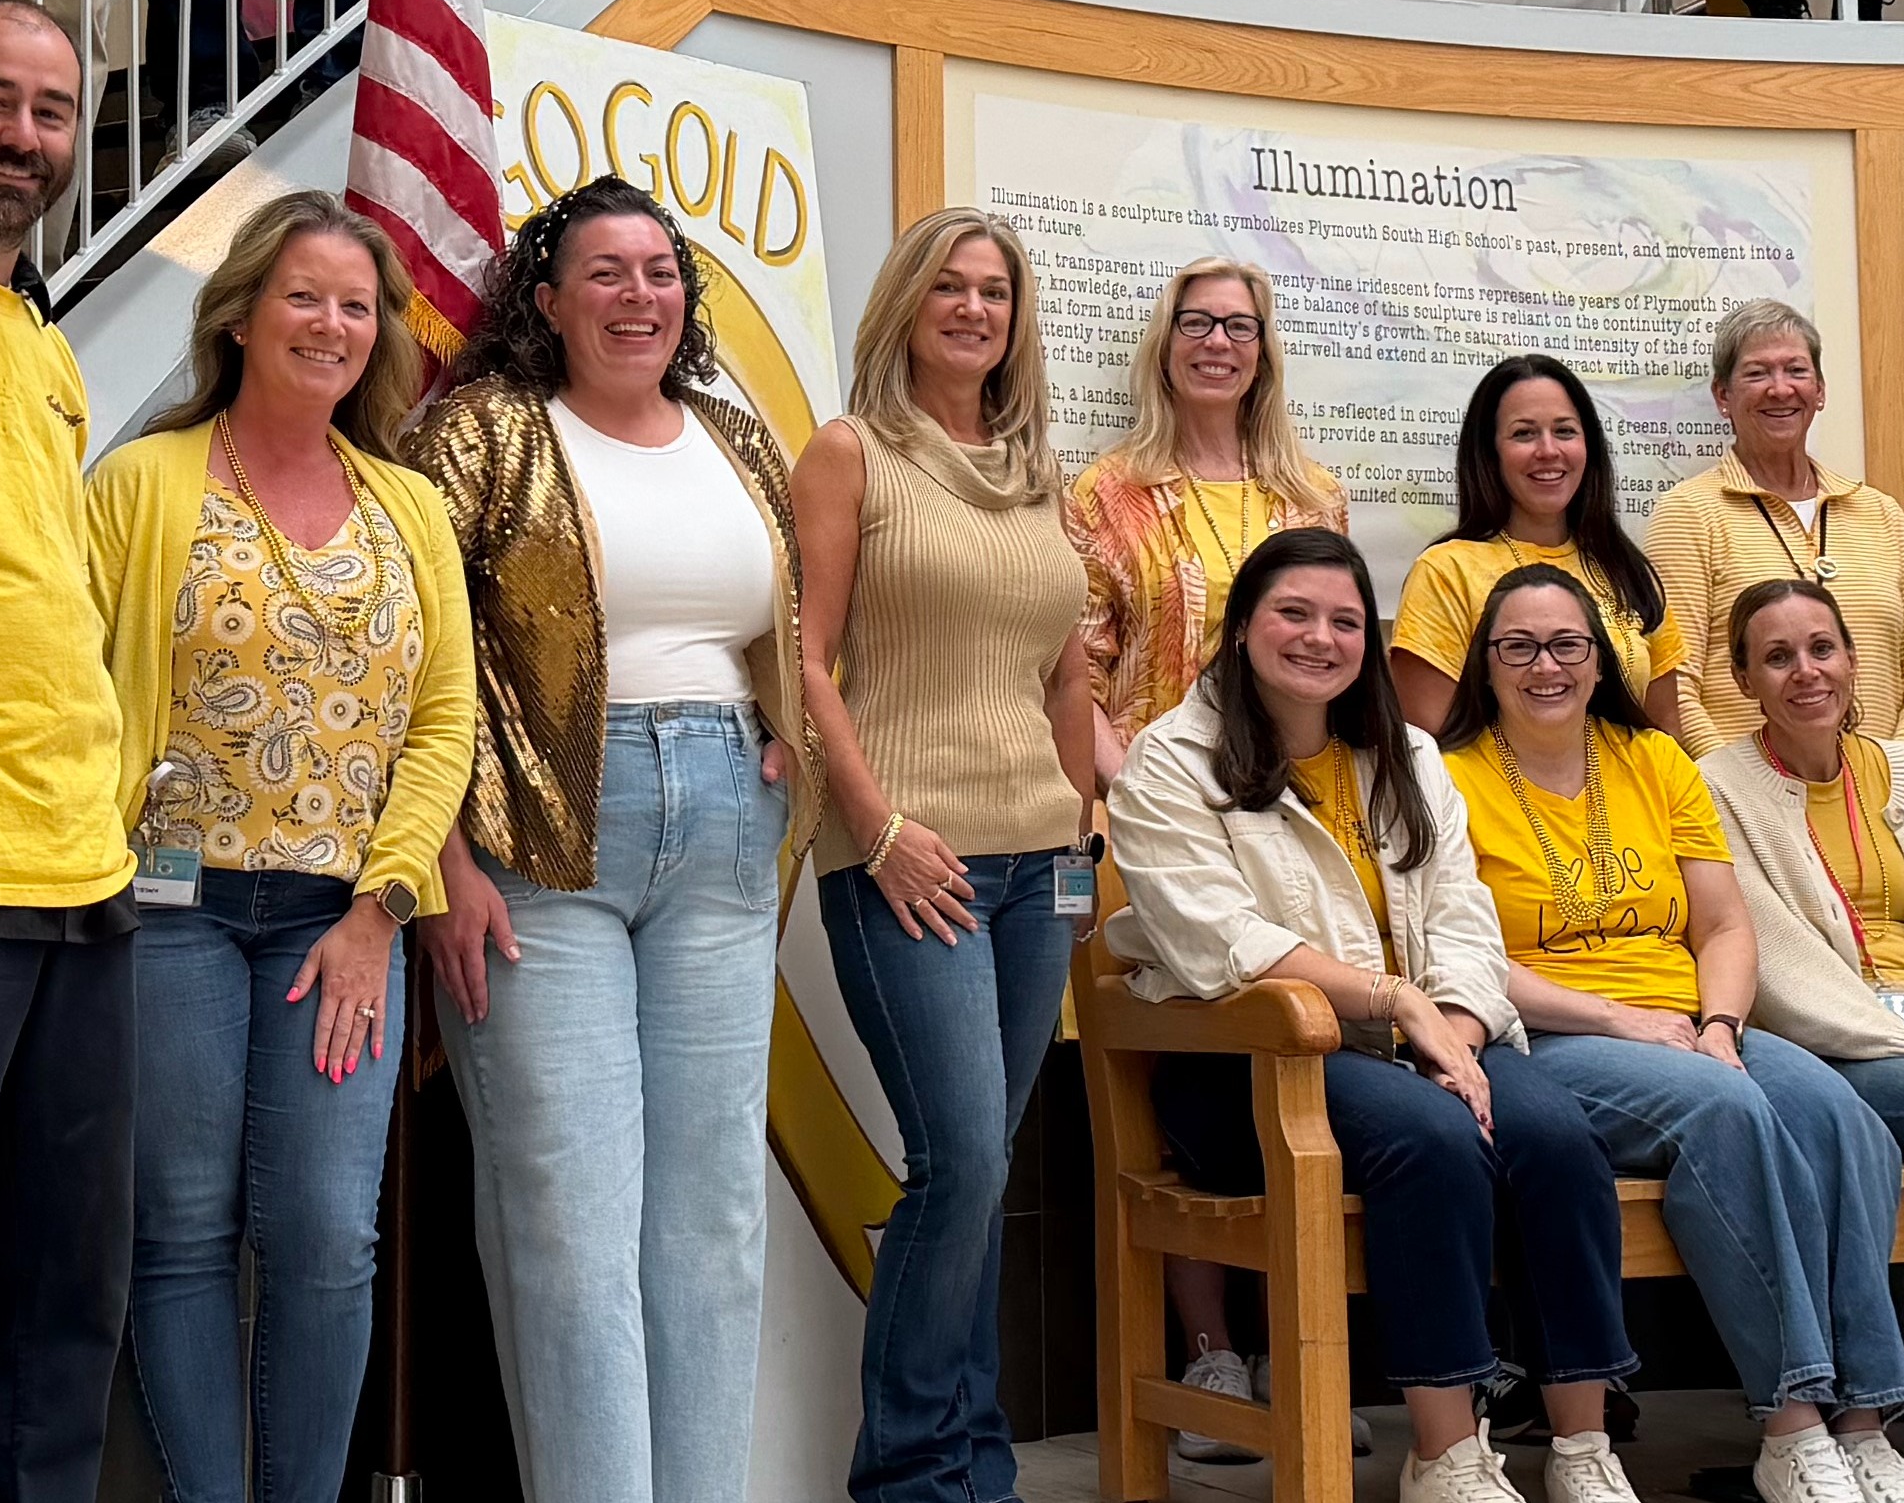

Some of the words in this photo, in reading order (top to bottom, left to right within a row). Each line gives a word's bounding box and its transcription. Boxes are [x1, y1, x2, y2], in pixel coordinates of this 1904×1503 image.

[603, 79, 808, 267] GOLD
[1251, 147, 1519, 213] Illumination
[991, 187, 1077, 213] Illumination
[1083, 199, 1093, 215] is
[1099, 204, 1107, 216] a
[1112, 204, 1183, 224] sculpture
[1188, 210, 1219, 227] that
[1224, 214, 1303, 234] symbolizes
[1308, 220, 1377, 240] Plymouth
[1382, 225, 1423, 243] South
[1428, 229, 1460, 248] High
[1465, 232, 1522, 250] School's
[1526, 239, 1561, 256] past,
[1566, 241, 1627, 259] present,
[1633, 242, 1661, 257] and
[1666, 245, 1745, 259] movement
[1751, 245, 1781, 260] into
[1786, 248, 1794, 260] a
[1038, 216, 1086, 237] future.
[1050, 275, 1132, 300] knowledge,
[1136, 284, 1163, 301] and
[1275, 293, 1299, 310] The
[1304, 296, 1359, 314] balance
[1364, 300, 1378, 316] of
[1382, 301, 1409, 317] this
[1414, 304, 1481, 323] sculpture
[1486, 308, 1497, 323] is
[1502, 309, 1551, 326] reliant
[1555, 316, 1571, 328] on
[1576, 314, 1598, 330] the
[1603, 317, 1683, 336] continuity
[1687, 318, 1702, 333] of
[1055, 252, 1145, 276] transparent
[1271, 272, 1353, 294] wenty-nine
[1356, 277, 1429, 297] iridescent
[1434, 282, 1474, 300] forms
[1479, 286, 1548, 305] represent
[1553, 291, 1575, 307] the
[1579, 296, 1620, 311] years
[1625, 294, 1639, 310] of
[1643, 295, 1717, 314] Plymouth
[1067, 299, 1102, 318] form
[1107, 305, 1134, 320] and
[1139, 309, 1150, 321] is
[1277, 320, 1369, 340] community's
[1375, 326, 1431, 345] growth.
[1434, 326, 1460, 343] The
[1465, 330, 1539, 347] saturation
[1544, 334, 1570, 350] and
[1574, 336, 1639, 357] intensity
[1645, 338, 1660, 354] of
[1664, 339, 1687, 354] the
[1053, 344, 1067, 361] of
[1070, 346, 1092, 363] the
[1098, 352, 1130, 368] past
[1283, 339, 1341, 358] tairwell
[1345, 344, 1372, 359] and
[1376, 347, 1427, 365] extend
[1431, 351, 1448, 364] an
[1607, 360, 1639, 375] with
[1645, 360, 1669, 376] the
[1674, 360, 1708, 379] light
[1064, 408, 1086, 425] the
[1090, 410, 1137, 429] future
[1319, 426, 1375, 443] provide
[1380, 430, 1398, 444] an
[1402, 431, 1459, 446] assured
[1623, 440, 1691, 459] strength,
[1696, 442, 1723, 457] and
[1069, 388, 1078, 401] a
[1313, 402, 1325, 417] is
[1330, 403, 1396, 421] reflected
[1401, 406, 1415, 422] in
[1617, 419, 1672, 436] greens,
[1347, 463, 1361, 479] of
[1365, 465, 1402, 480] color
[1350, 486, 1397, 503] united
